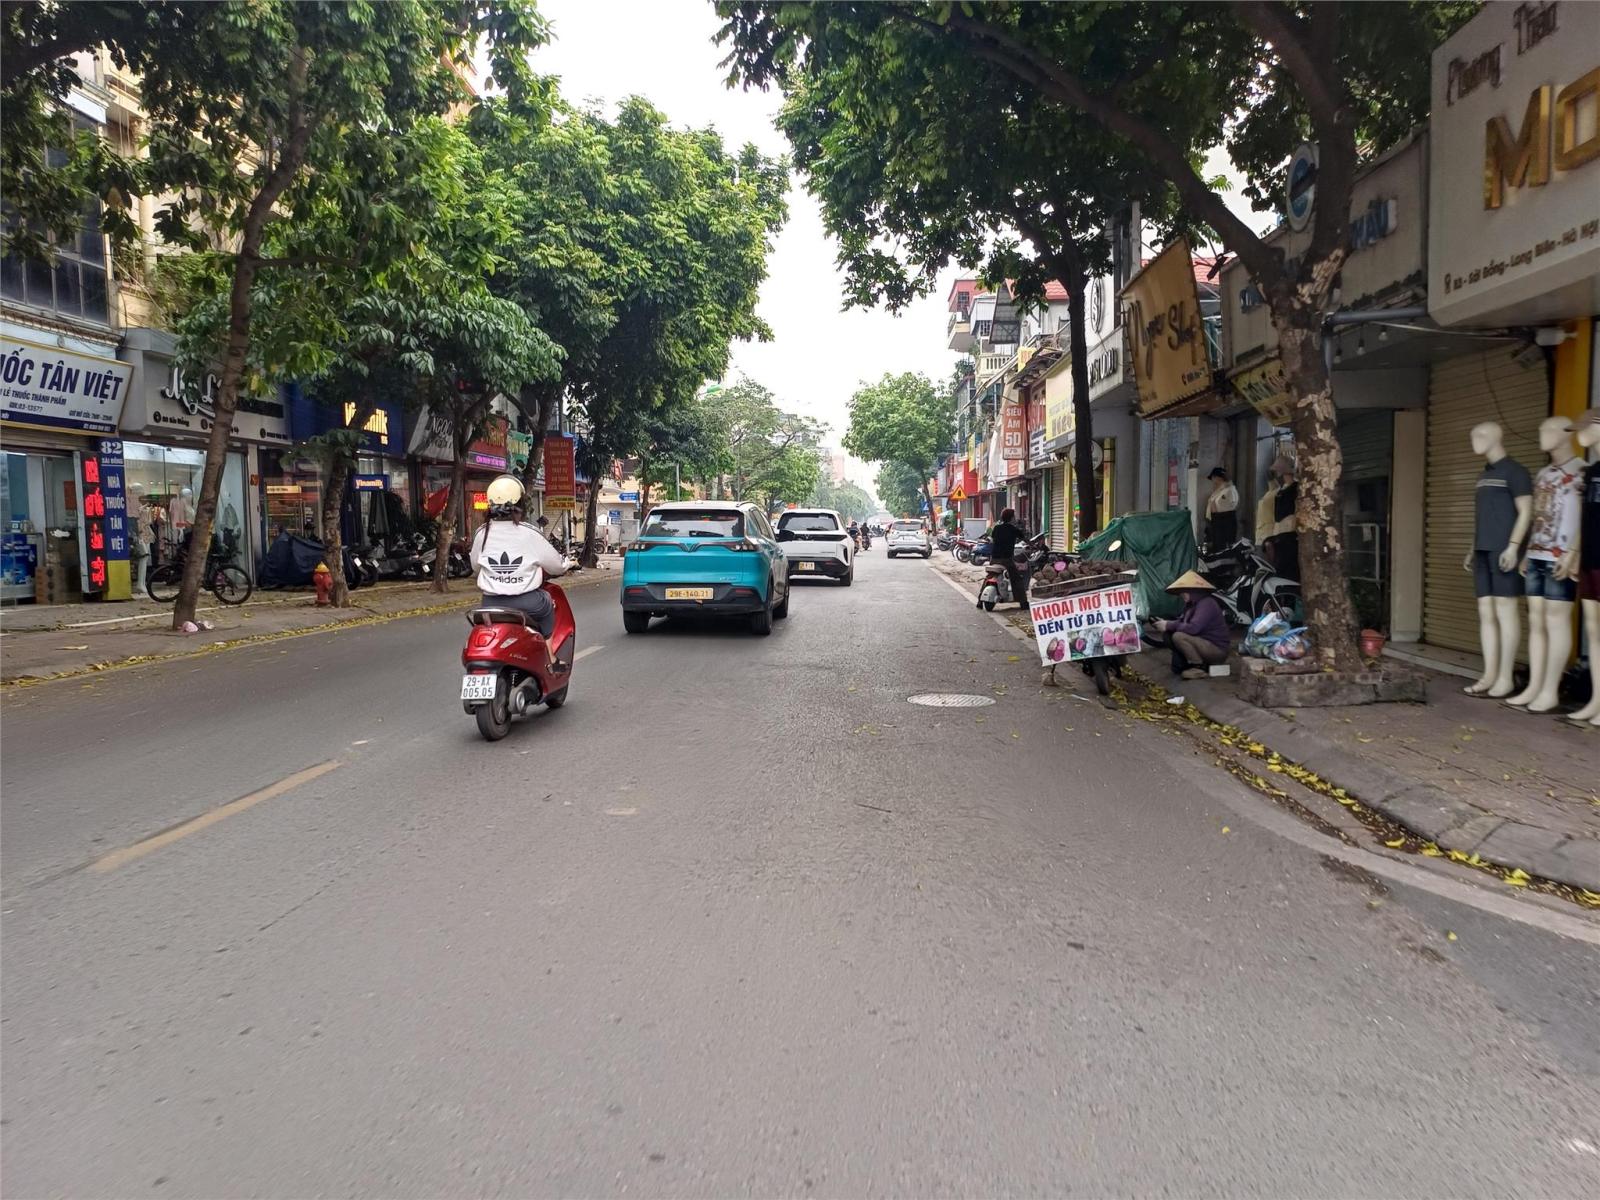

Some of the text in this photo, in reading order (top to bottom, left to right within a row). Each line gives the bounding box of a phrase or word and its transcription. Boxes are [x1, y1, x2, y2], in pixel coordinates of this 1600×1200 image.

[40, 359, 80, 394] TÂN
[83, 369, 124, 404] VIỆT
[1005, 431, 1021, 447] 5D
[101, 441, 123, 455] 82
[107, 472, 121, 489] NHÀ
[105, 493, 125, 509] THUỐC
[110, 536, 124, 553] VIỆT
[1032, 599, 1075, 622] KHOAI
[1105, 587, 1132, 608] TÍM
[1038, 608, 1132, 636] ĐẾN TỪ ĐÀ LẠT
[467, 676, 491, 687] 29-AX
[463, 687, 493, 698] 005.05
